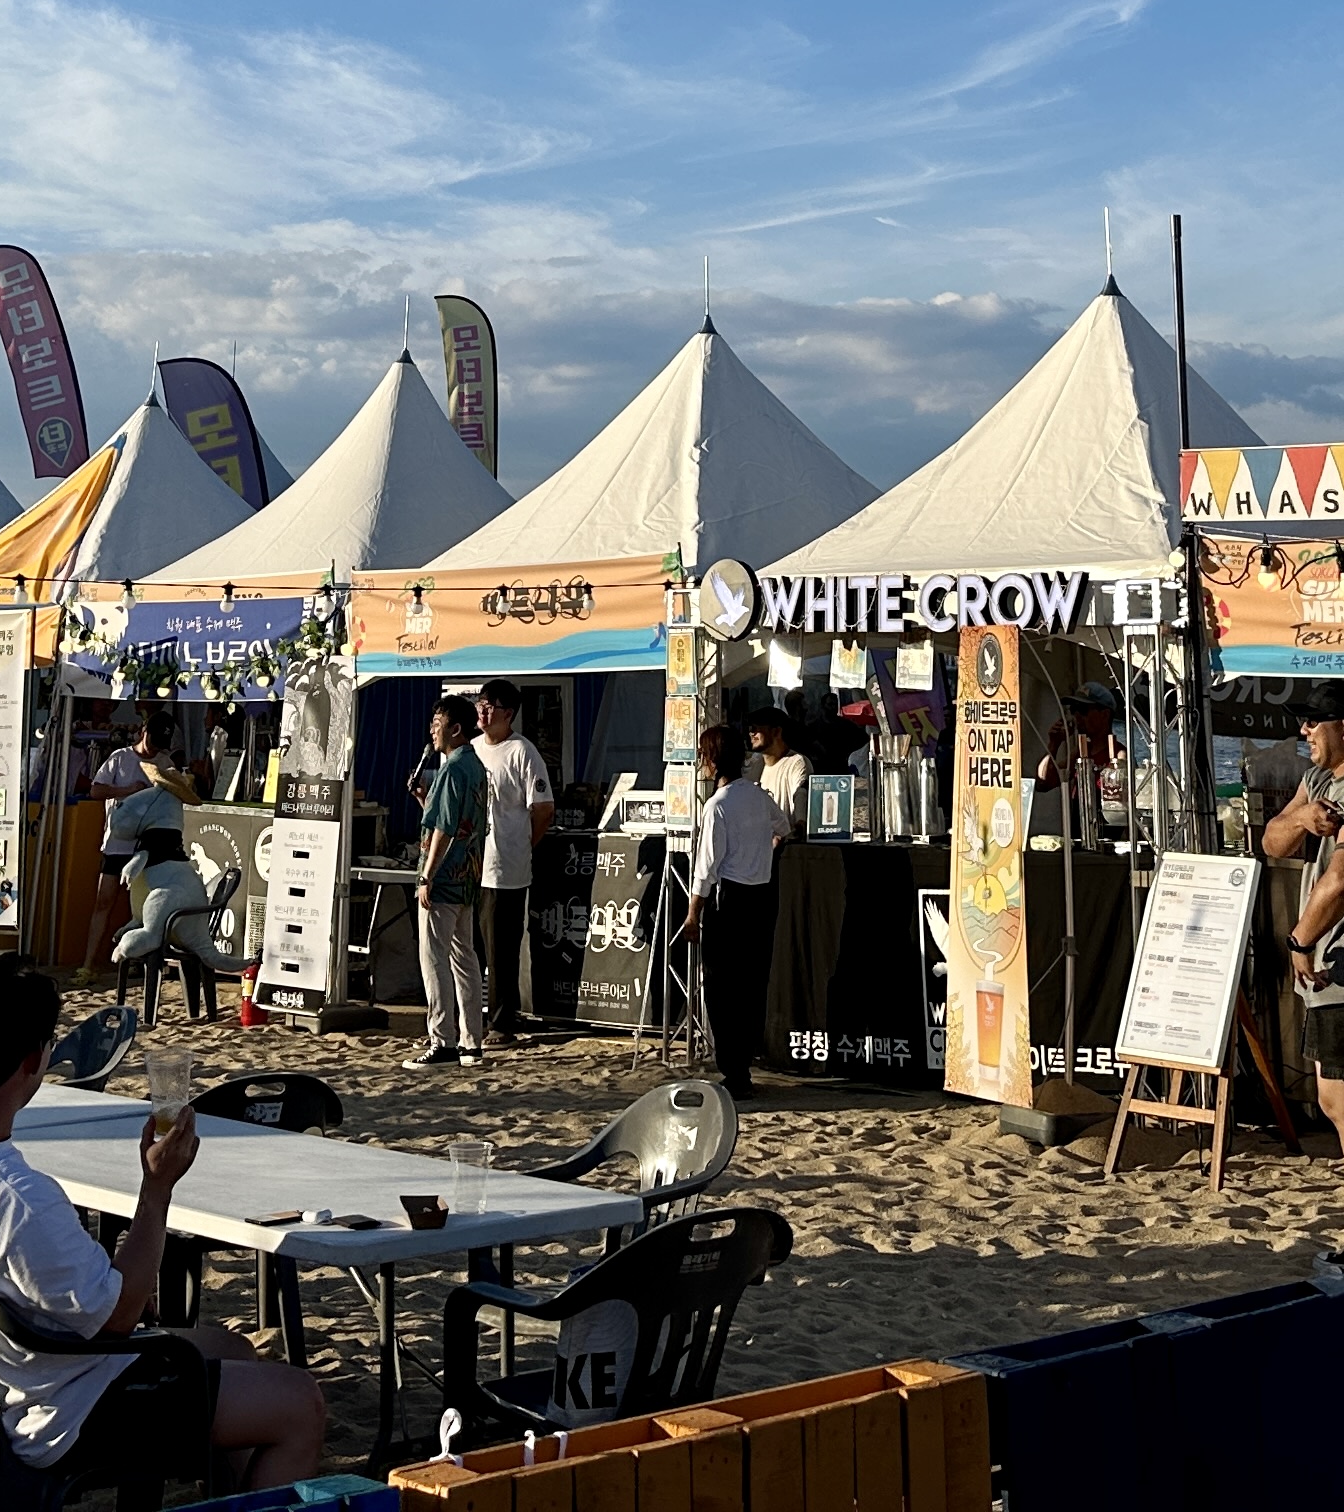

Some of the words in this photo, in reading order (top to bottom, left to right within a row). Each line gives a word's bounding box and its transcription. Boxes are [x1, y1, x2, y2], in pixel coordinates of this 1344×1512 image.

[762, 573, 908, 633] WHITE
[920, 571, 1089, 634] CROW
[406, 617, 432, 635] MER
[964, 700, 1018, 726] 화이트크로우
[968, 729, 987, 752] ON
[990, 729, 1014, 754] TAP
[969, 757, 1013, 788] HERE
[286, 782, 331, 801] 강릉맥주
[565, 850, 626, 877] 강릉맥주
[789, 1029, 830, 1062] 평창
[837, 1033, 912, 1068] 수제맥주
[1029, 1045, 1066, 1075] 이트
